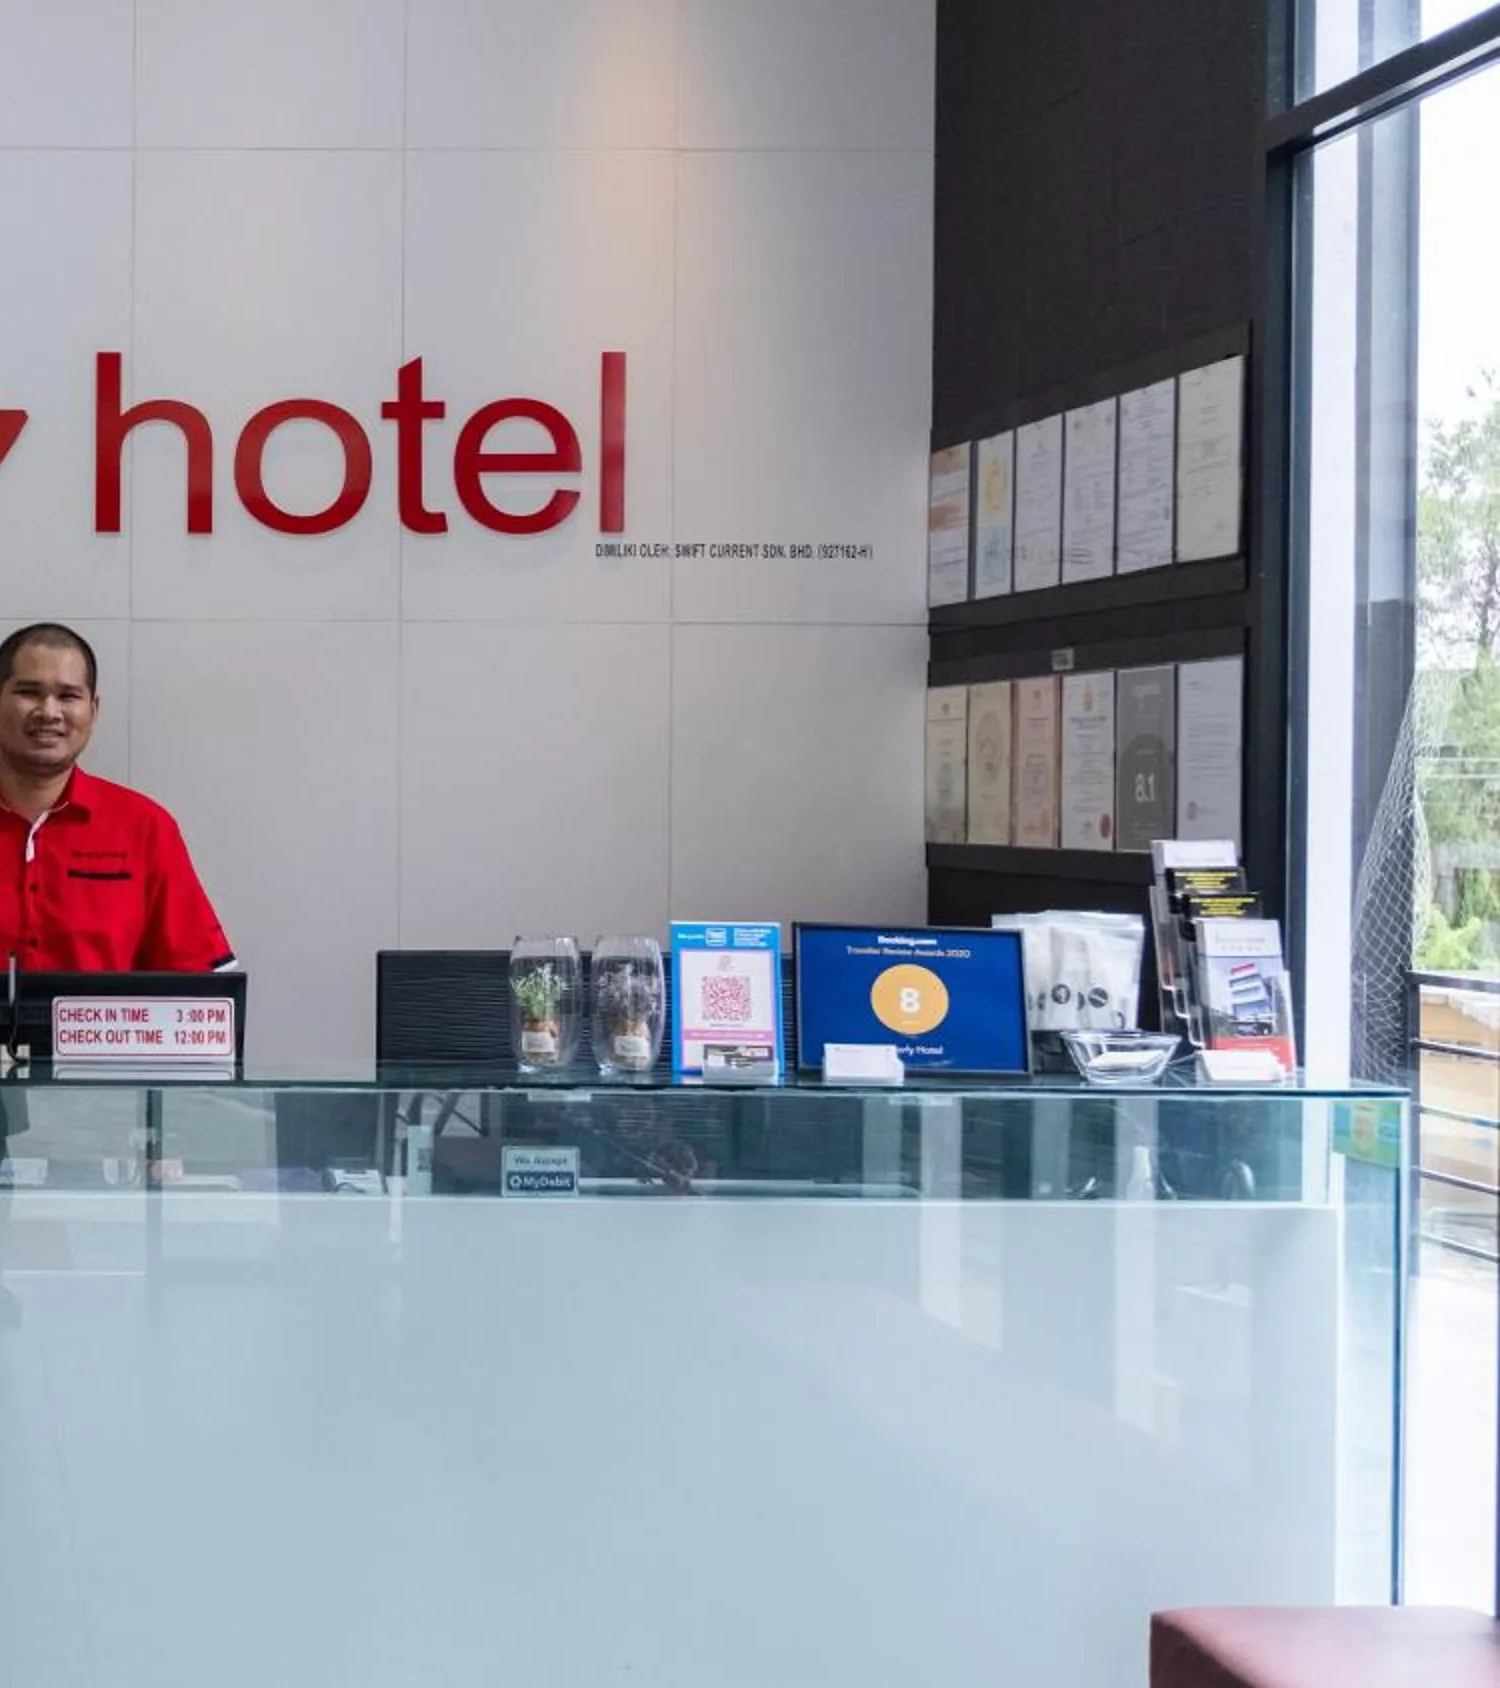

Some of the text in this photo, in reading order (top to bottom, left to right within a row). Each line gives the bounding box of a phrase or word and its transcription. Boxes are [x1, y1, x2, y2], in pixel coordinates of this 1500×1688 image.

[94, 350, 627, 536] hotel
[595, 543, 637, 558] DIMILIKI
[675, 543, 706, 558] SWIFT
[709, 543, 760, 559] CURRENT
[900, 986, 921, 1013] 8
[59, 1008, 101, 1023] CHECK
[105, 1008, 117, 1023] IN
[121, 1008, 149, 1023] TIME
[207, 1009, 226, 1023] PM
[59, 1029, 226, 1045] CHECK OUT TIME 12:00 PM
